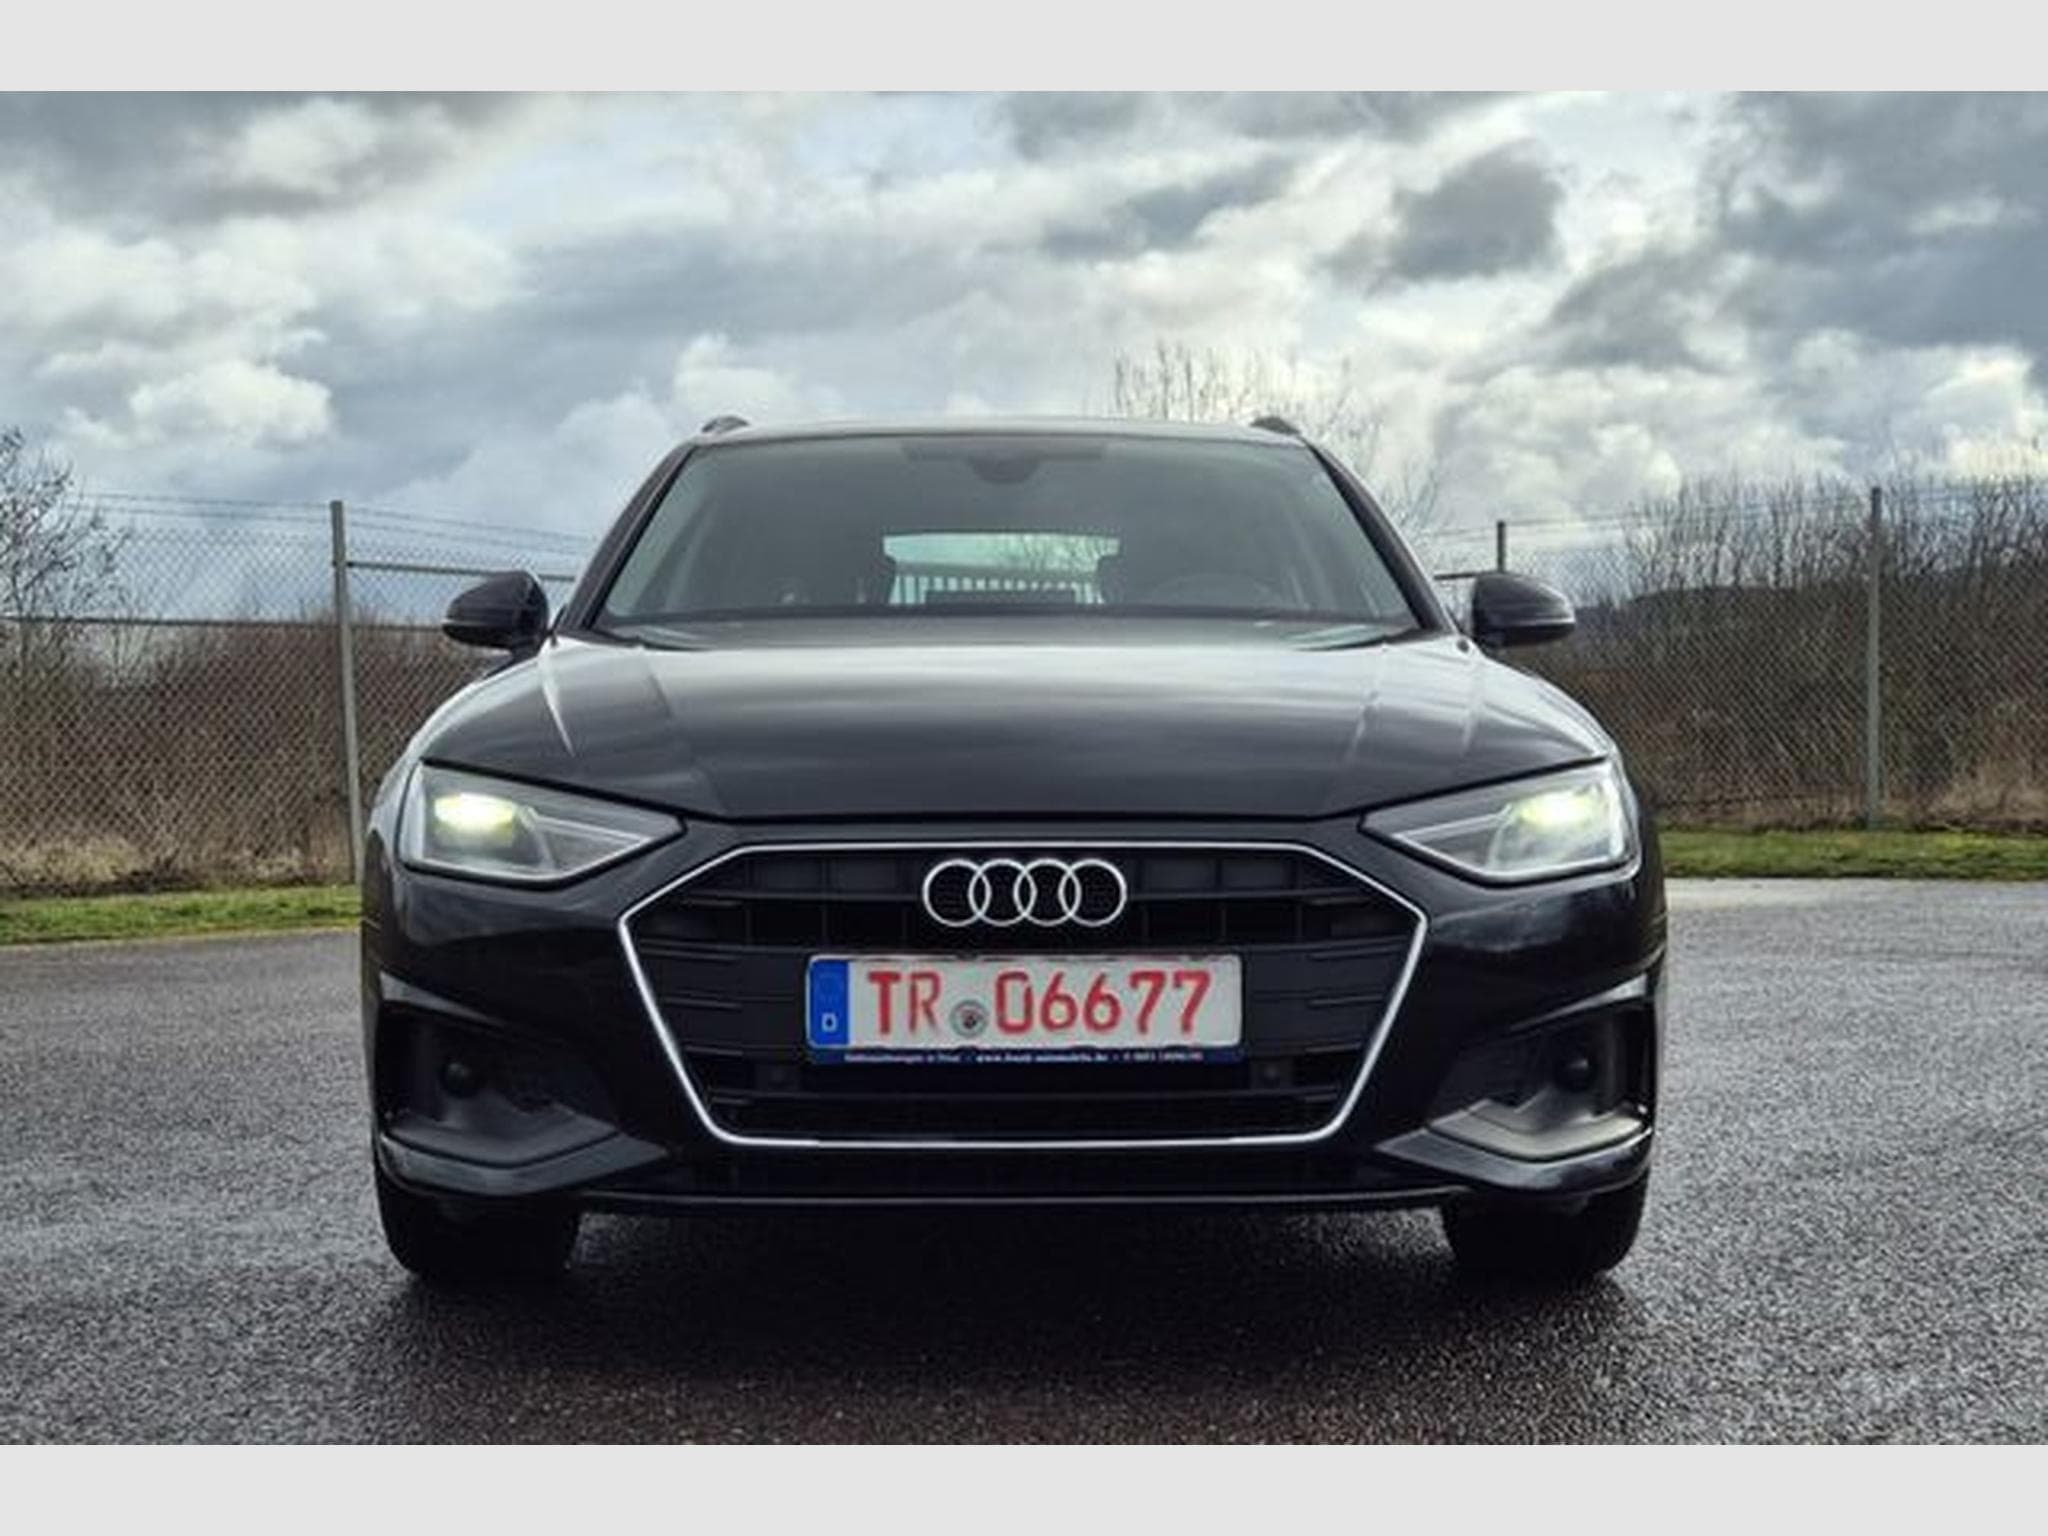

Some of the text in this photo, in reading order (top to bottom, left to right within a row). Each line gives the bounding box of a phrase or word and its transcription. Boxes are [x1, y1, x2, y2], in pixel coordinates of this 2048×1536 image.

[868, 969, 1212, 1034] TR 06677
[821, 1013, 838, 1033] D
